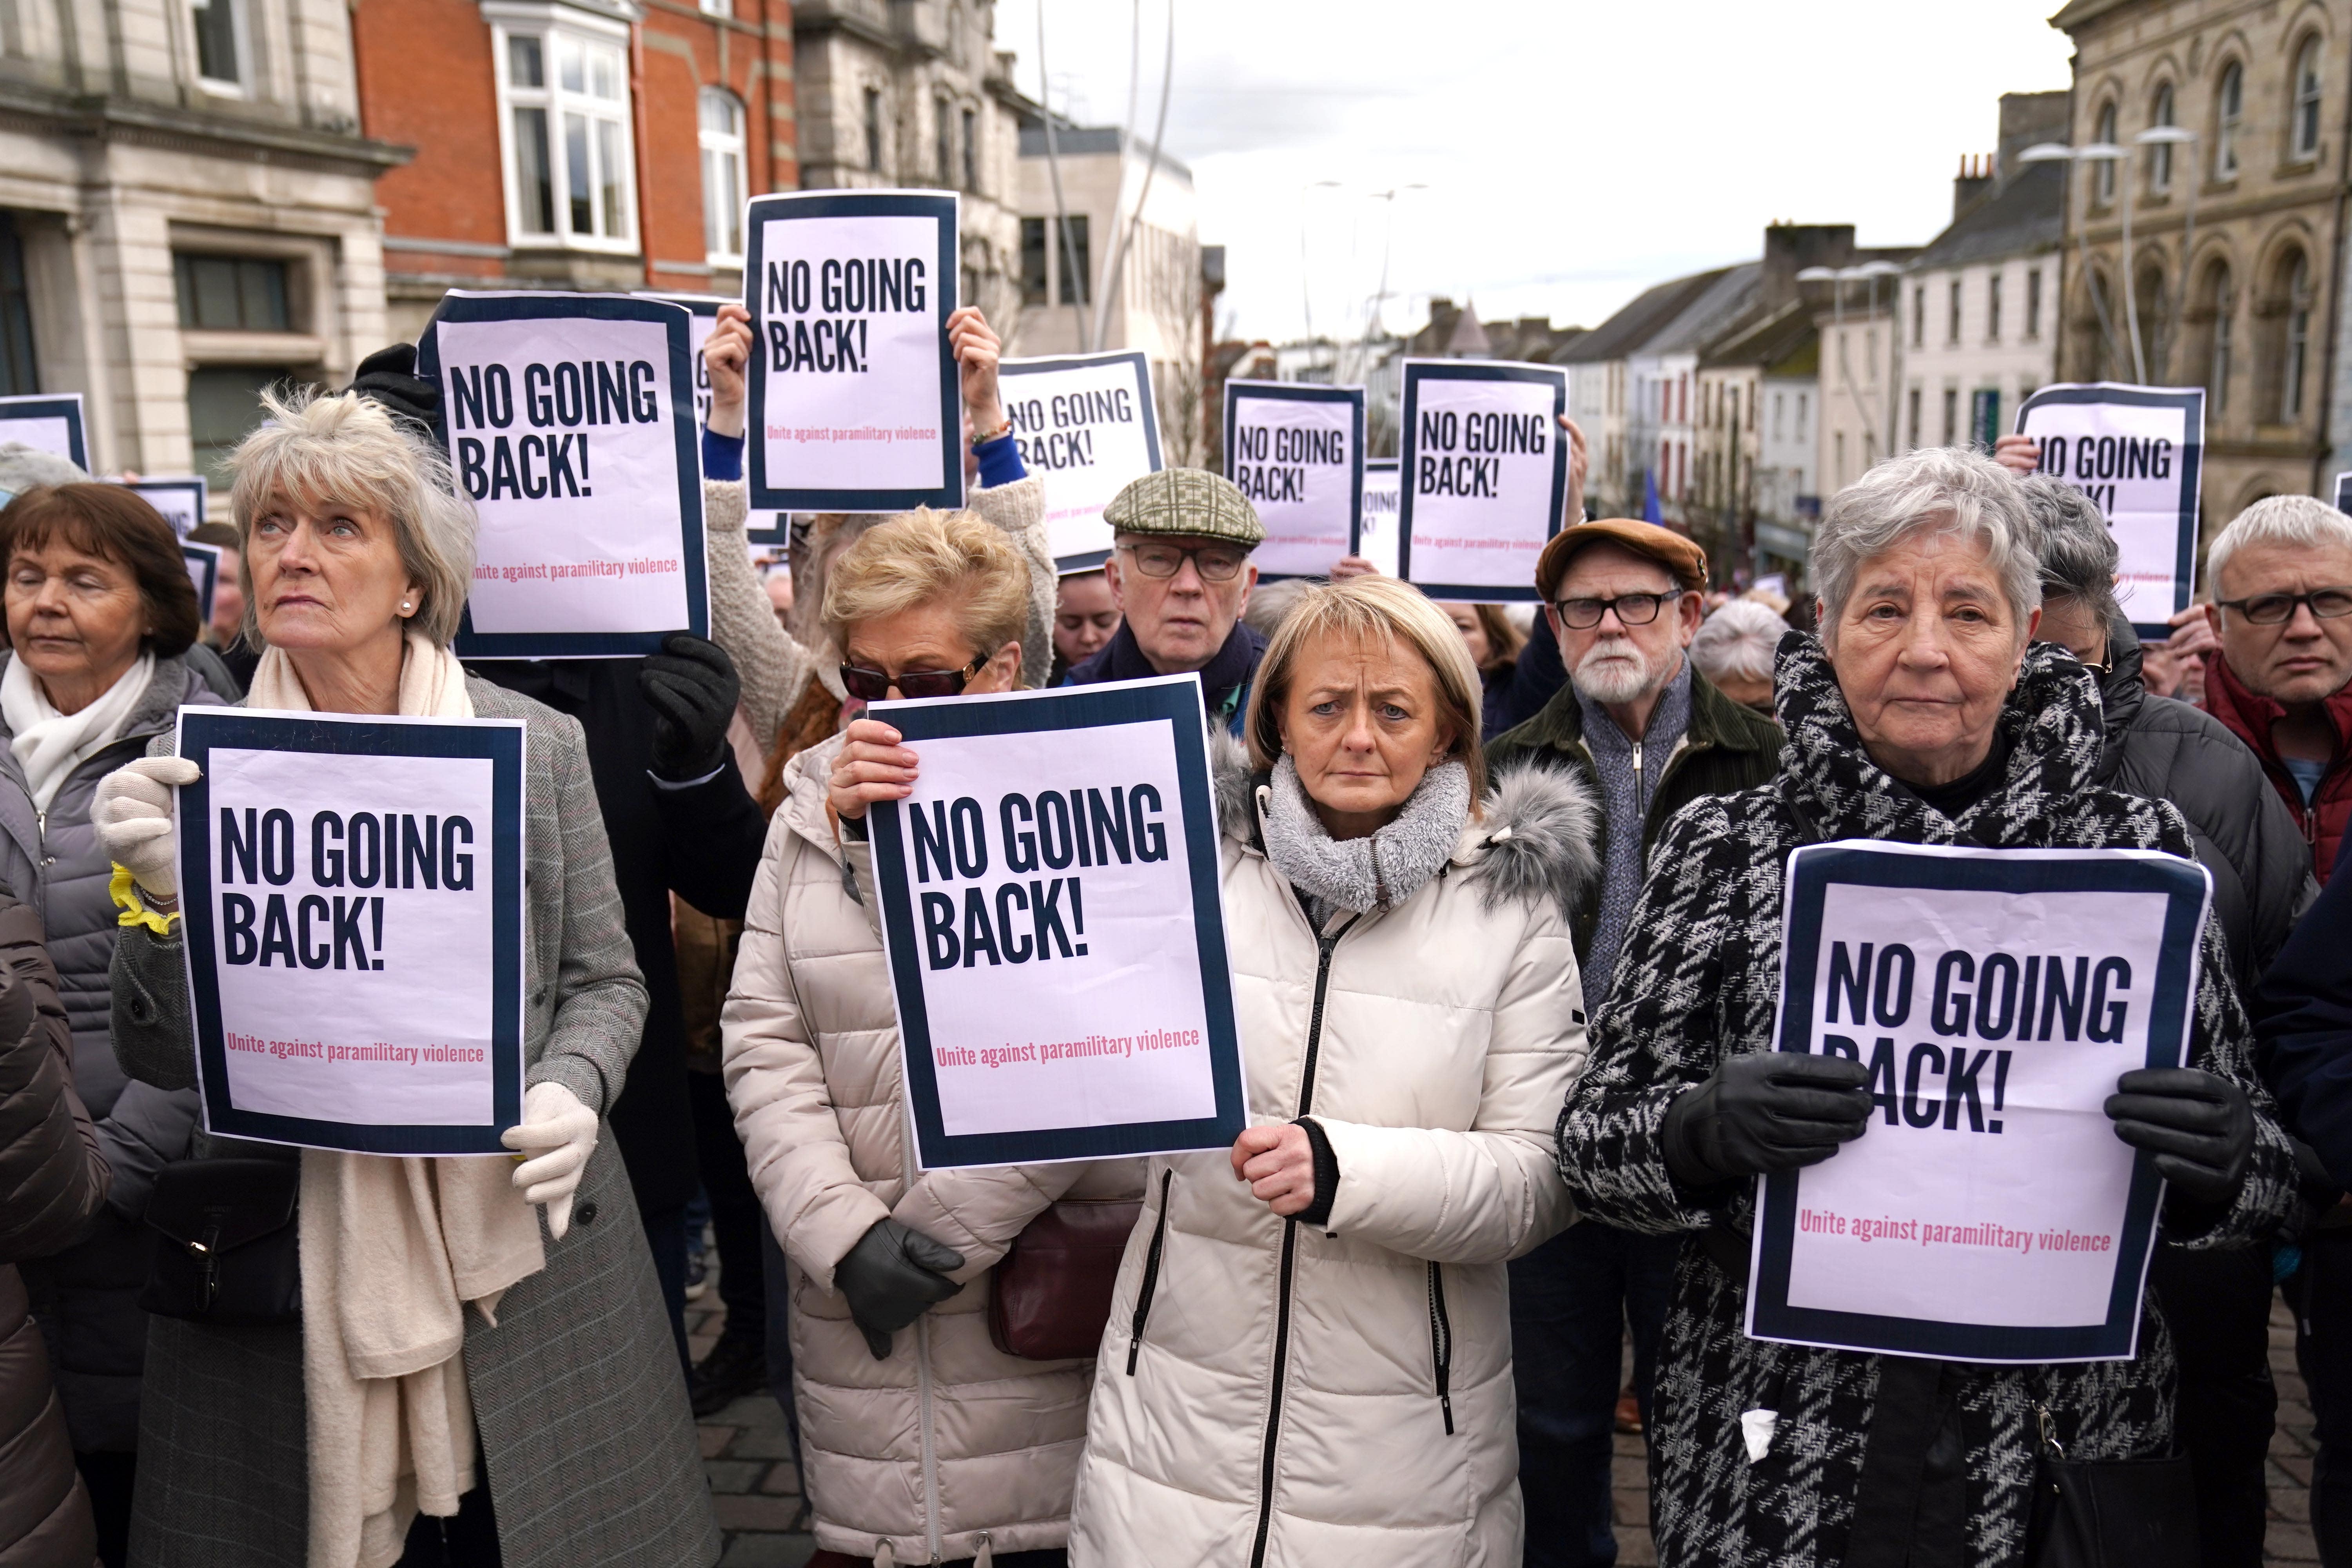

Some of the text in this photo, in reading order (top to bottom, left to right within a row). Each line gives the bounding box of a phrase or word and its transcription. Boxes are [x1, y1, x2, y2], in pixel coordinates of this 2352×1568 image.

[768, 258, 926, 314] NO GOING
[768, 319, 868, 373] BACK!
[450, 363, 513, 430] NO
[524, 361, 658, 428] GOING
[1007, 388, 1132, 432] NO GOING
[767, 425, 936, 443] Unite against paramilitary violence
[1240, 426, 1343, 465] NO GOING
[1421, 411, 1545, 454] NO GOING
[457, 434, 591, 500] BACK!
[1420, 456, 1499, 498] BACK!
[2076, 436, 2171, 479] GOING
[1239, 466, 1304, 503] BACK!
[472, 557, 677, 583] nite against paramilitary violence
[221, 808, 474, 890] NO GOING
[909, 784, 1168, 883] NO GOING
[223, 893, 384, 971] BACK!
[920, 877, 1088, 971] BACK!
[1825, 941, 2131, 1045] NO GOING
[227, 1032, 483, 1065] Unite against paramilitary violence
[937, 1029, 1199, 1068] Unite against paramilitary violence
[1800, 1209, 2110, 1254] Unite against paramilitary violence
